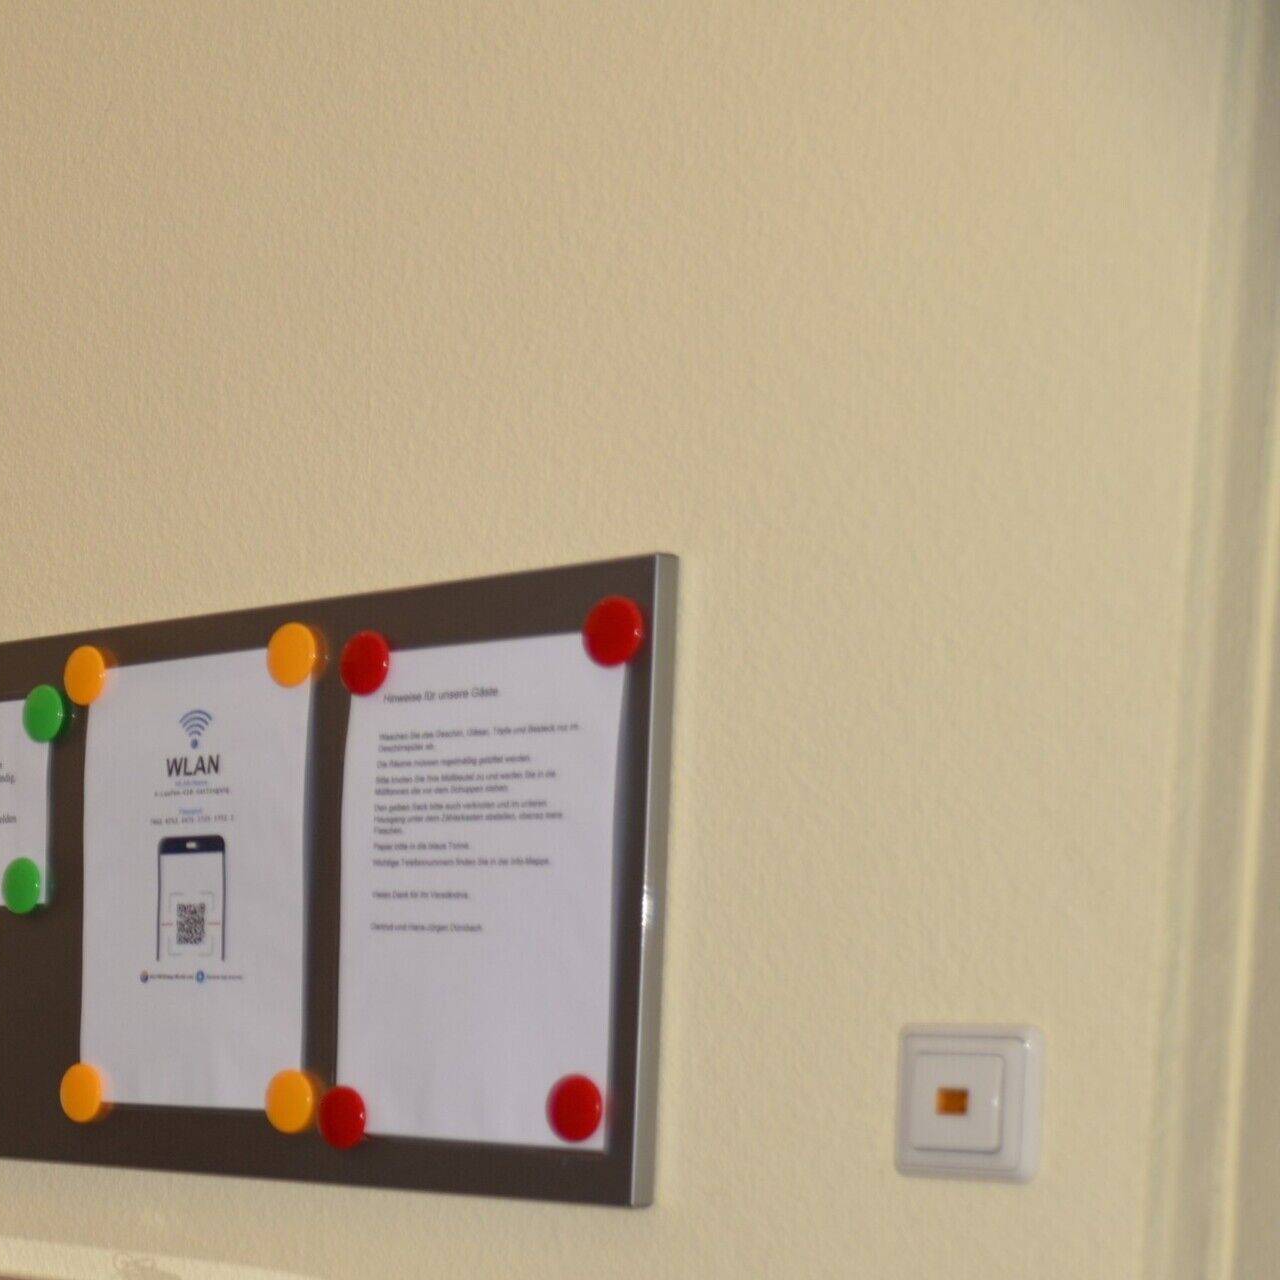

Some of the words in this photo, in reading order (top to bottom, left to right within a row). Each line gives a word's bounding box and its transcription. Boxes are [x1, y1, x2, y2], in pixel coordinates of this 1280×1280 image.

[383, 692, 422, 703] Hinweise
[423, 690, 436, 701] für
[438, 689, 469, 700] unsere
[166, 754, 220, 777] WLAN
